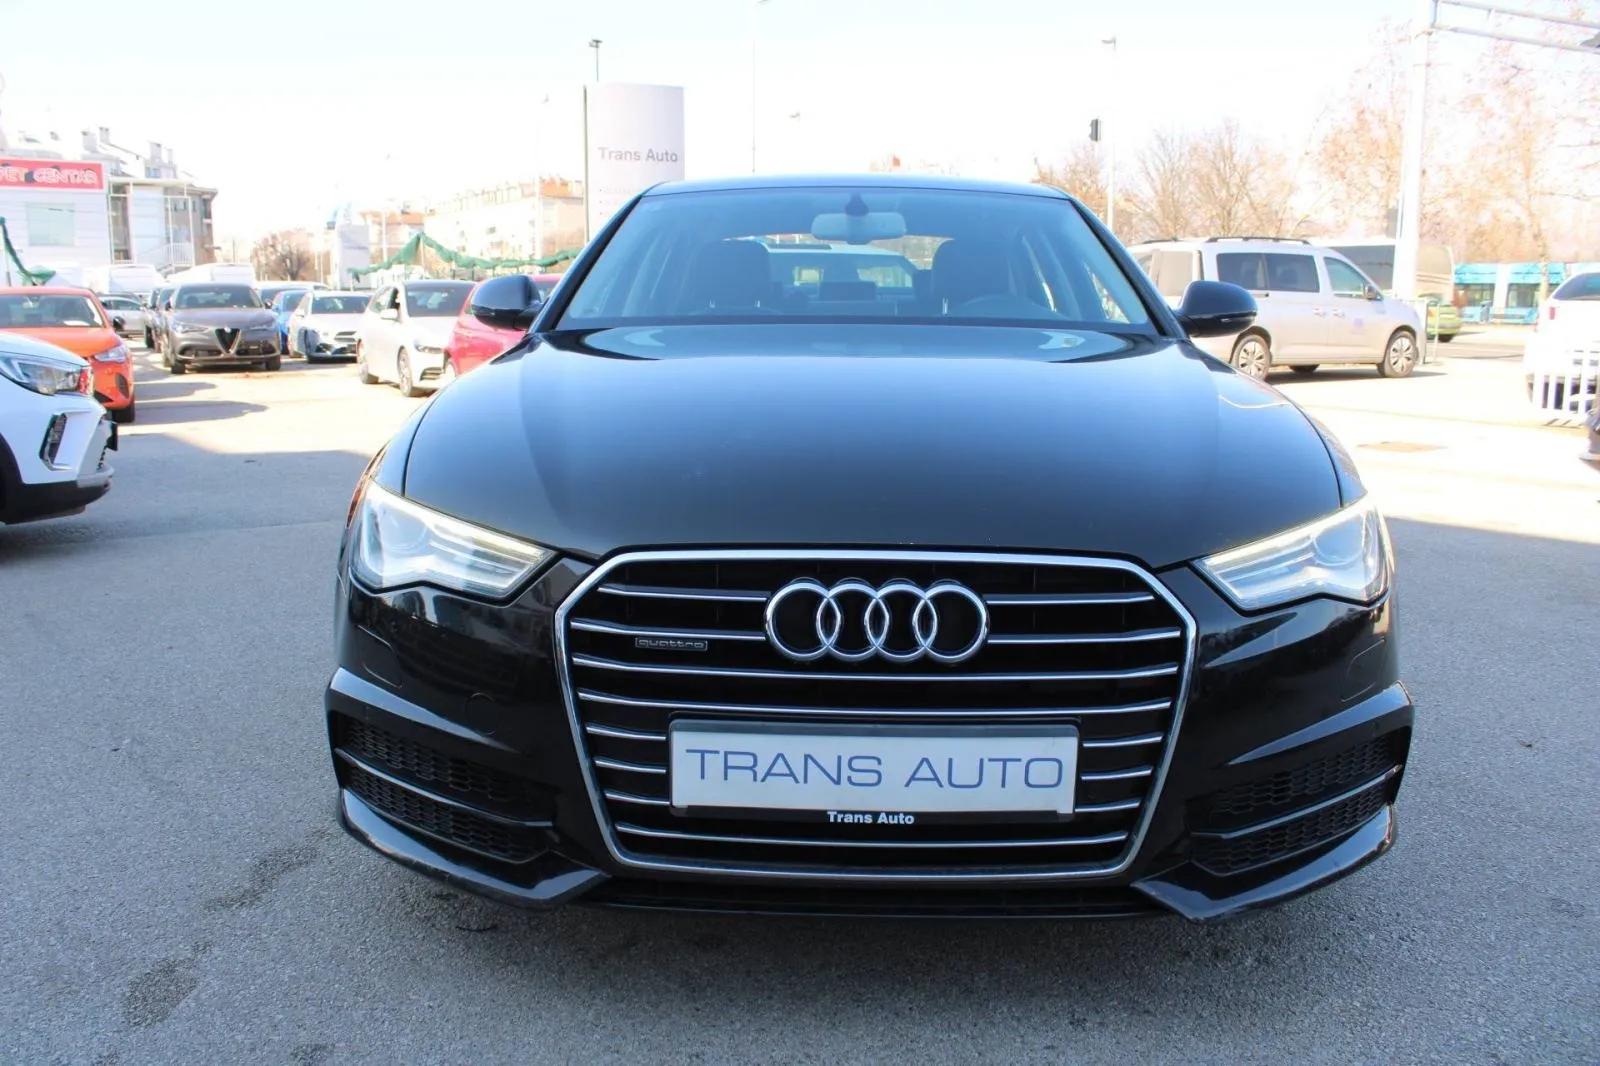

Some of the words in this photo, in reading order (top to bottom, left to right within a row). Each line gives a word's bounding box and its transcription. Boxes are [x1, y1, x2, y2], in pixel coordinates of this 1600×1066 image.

[598, 147, 641, 161] Trans
[645, 148, 679, 162] Auto
[33, 167, 98, 184] CENTAR
[638, 639, 705, 649] quattro
[686, 749, 883, 787] TRANS
[904, 757, 1063, 789] AUTO
[827, 811, 873, 825] Trans
[877, 812, 915, 825] Auto
